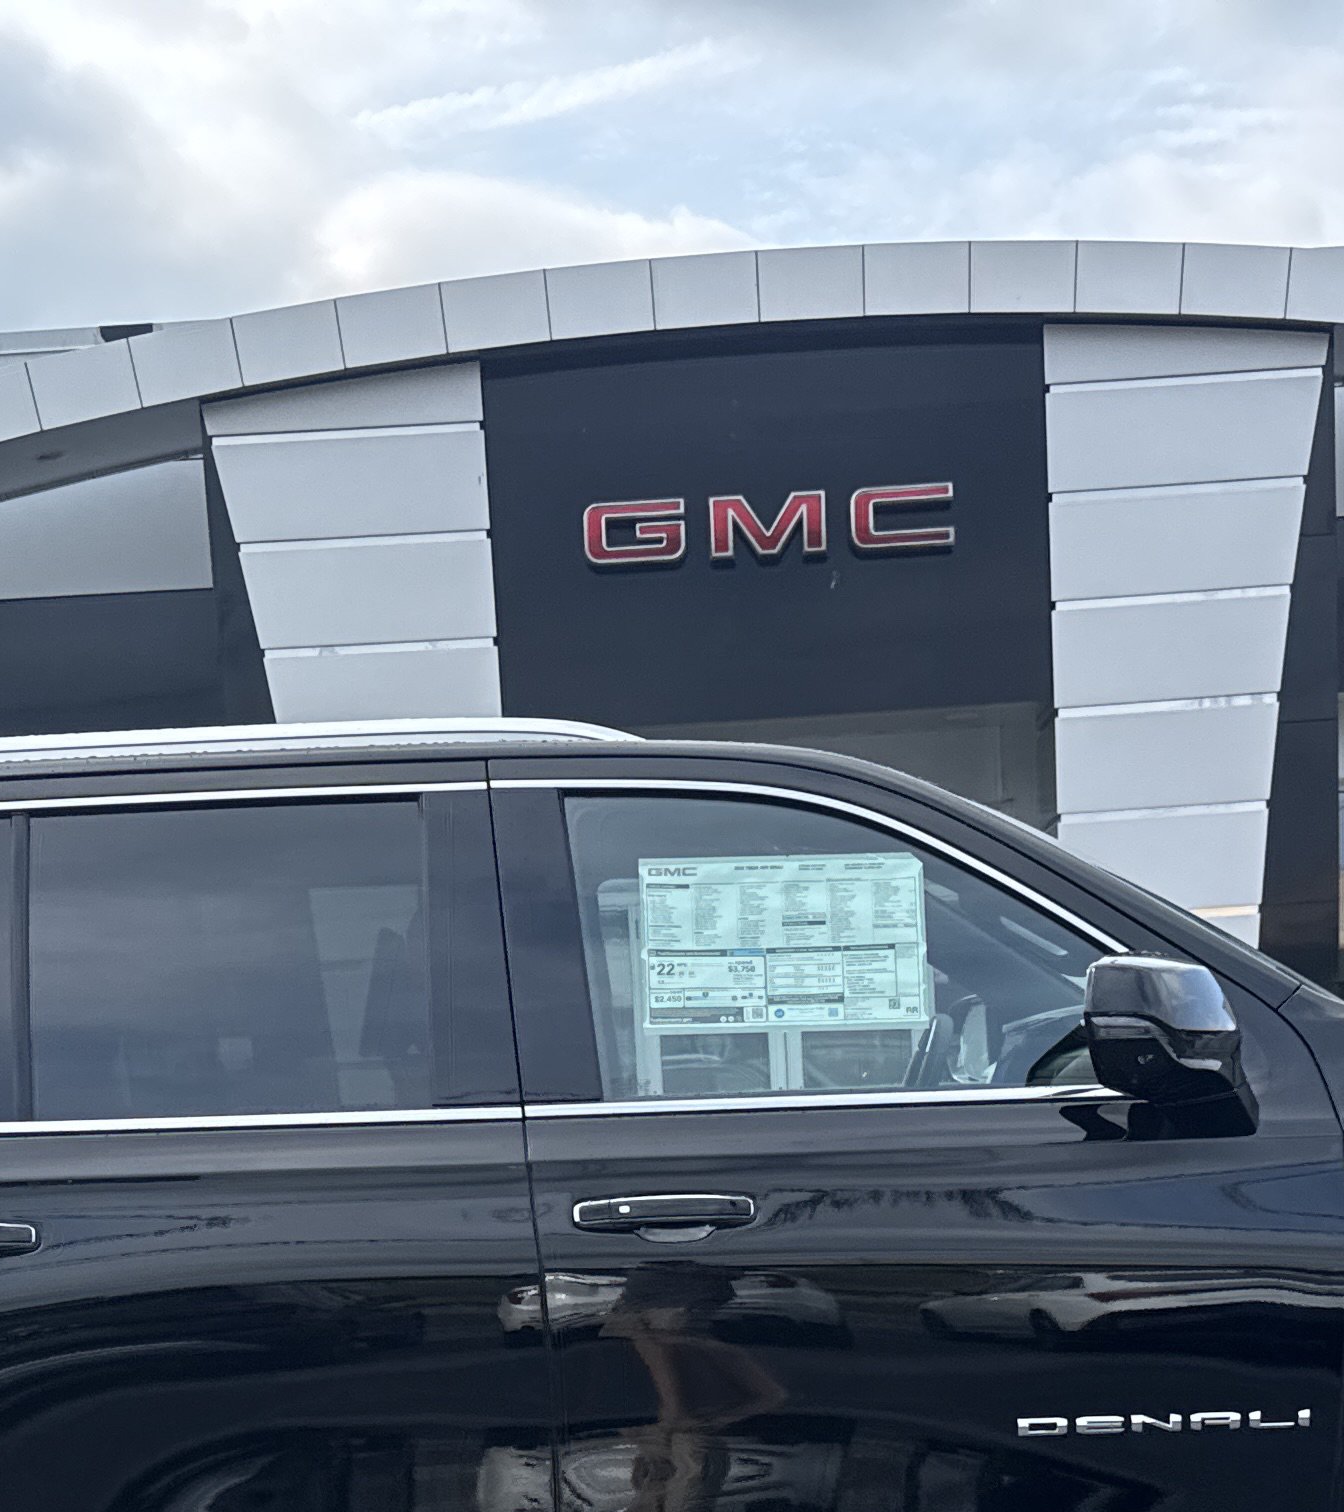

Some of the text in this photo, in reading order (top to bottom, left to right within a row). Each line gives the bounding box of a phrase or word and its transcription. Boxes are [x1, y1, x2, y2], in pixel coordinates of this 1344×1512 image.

[583, 482, 955, 565] GMC
[647, 866, 698, 877] GMC
[656, 963, 675, 976] 22
[1017, 1408, 1311, 1437] DENALI
